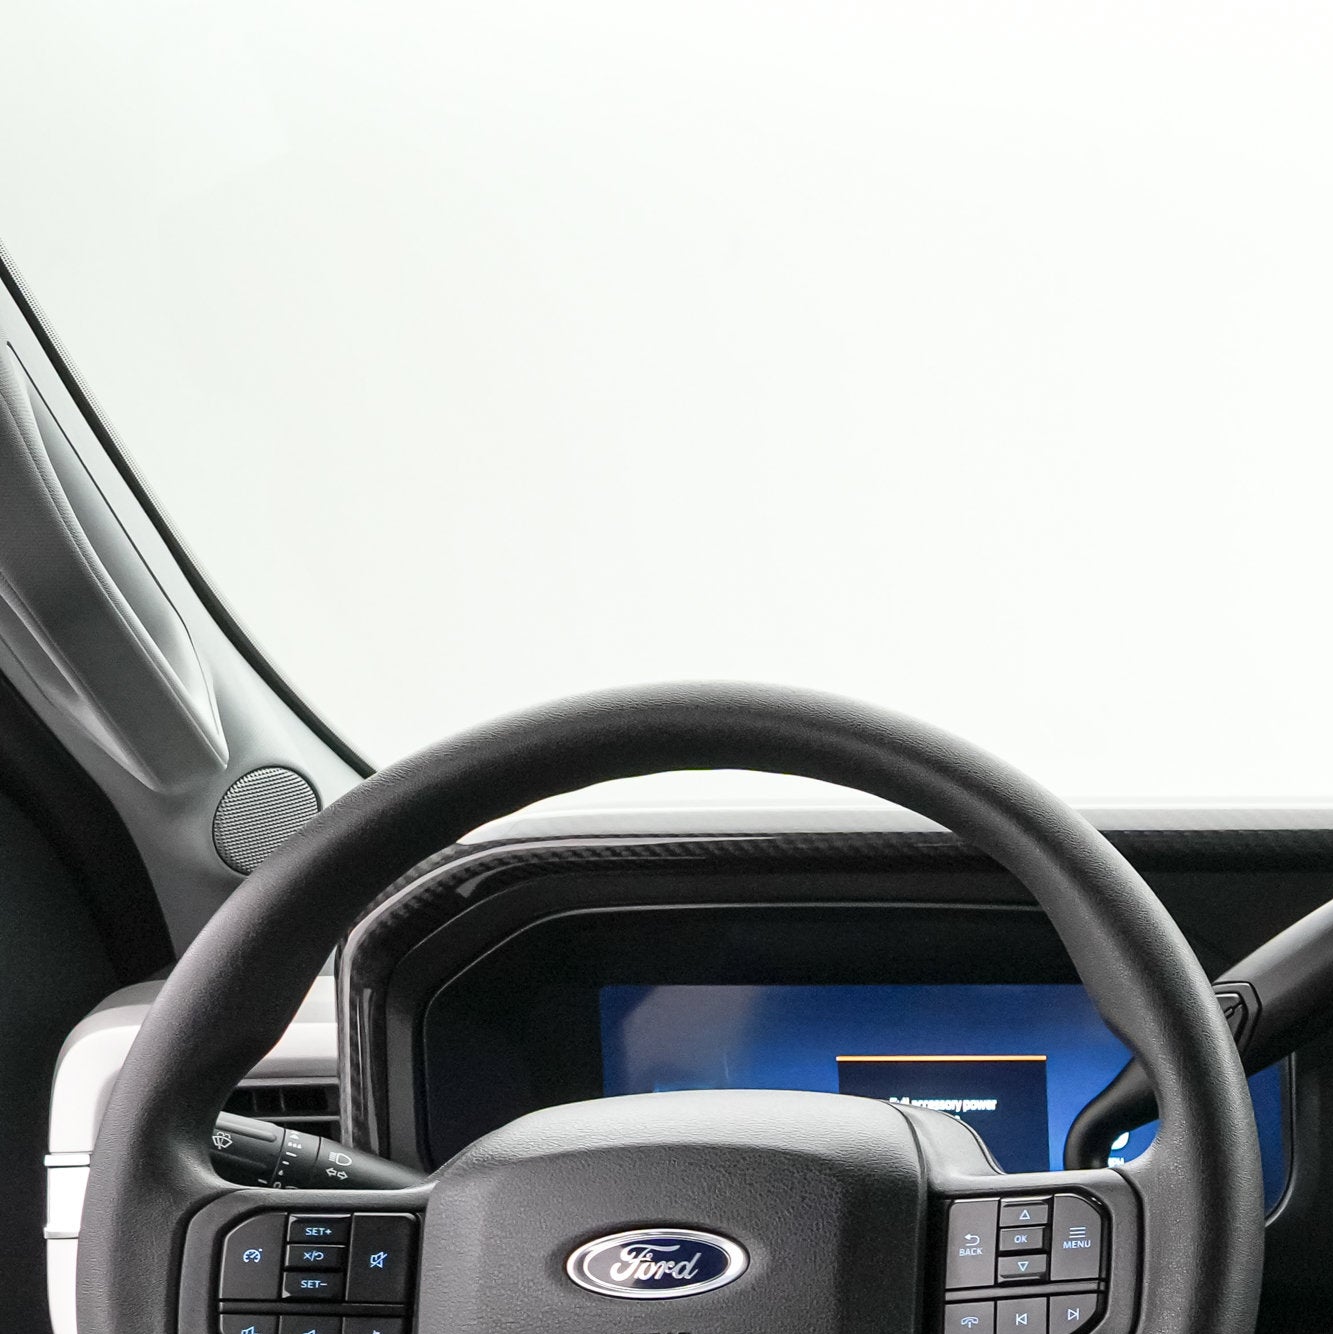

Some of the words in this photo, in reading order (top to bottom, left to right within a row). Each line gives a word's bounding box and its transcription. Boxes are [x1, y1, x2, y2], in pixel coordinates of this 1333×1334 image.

[963, 1099, 998, 1112] power
[1013, 1234, 1028, 1243] OK
[1062, 1239, 1091, 1250] MENU
[959, 1247, 983, 1257] BACK
[609, 1244, 700, 1283] Ford
